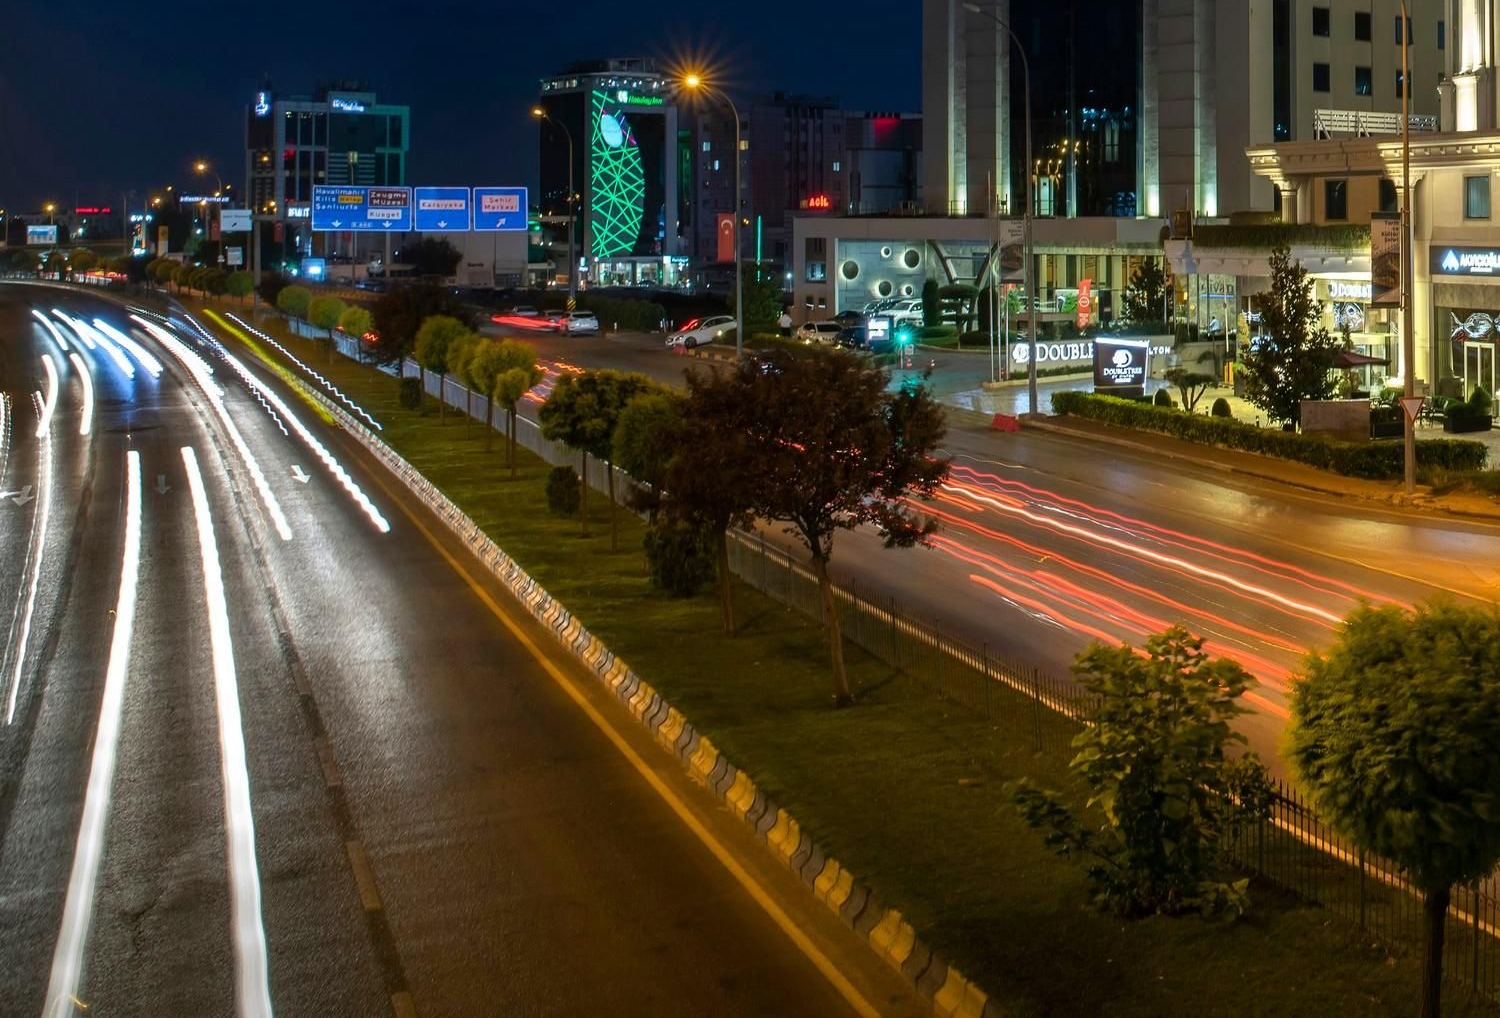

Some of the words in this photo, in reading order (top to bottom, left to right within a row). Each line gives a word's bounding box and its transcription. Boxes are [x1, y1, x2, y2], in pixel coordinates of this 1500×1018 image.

[370, 191, 407, 199] Zeugma
[1035, 342, 1094, 362] DOUBLE
[1149, 346, 1170, 355] LTON
